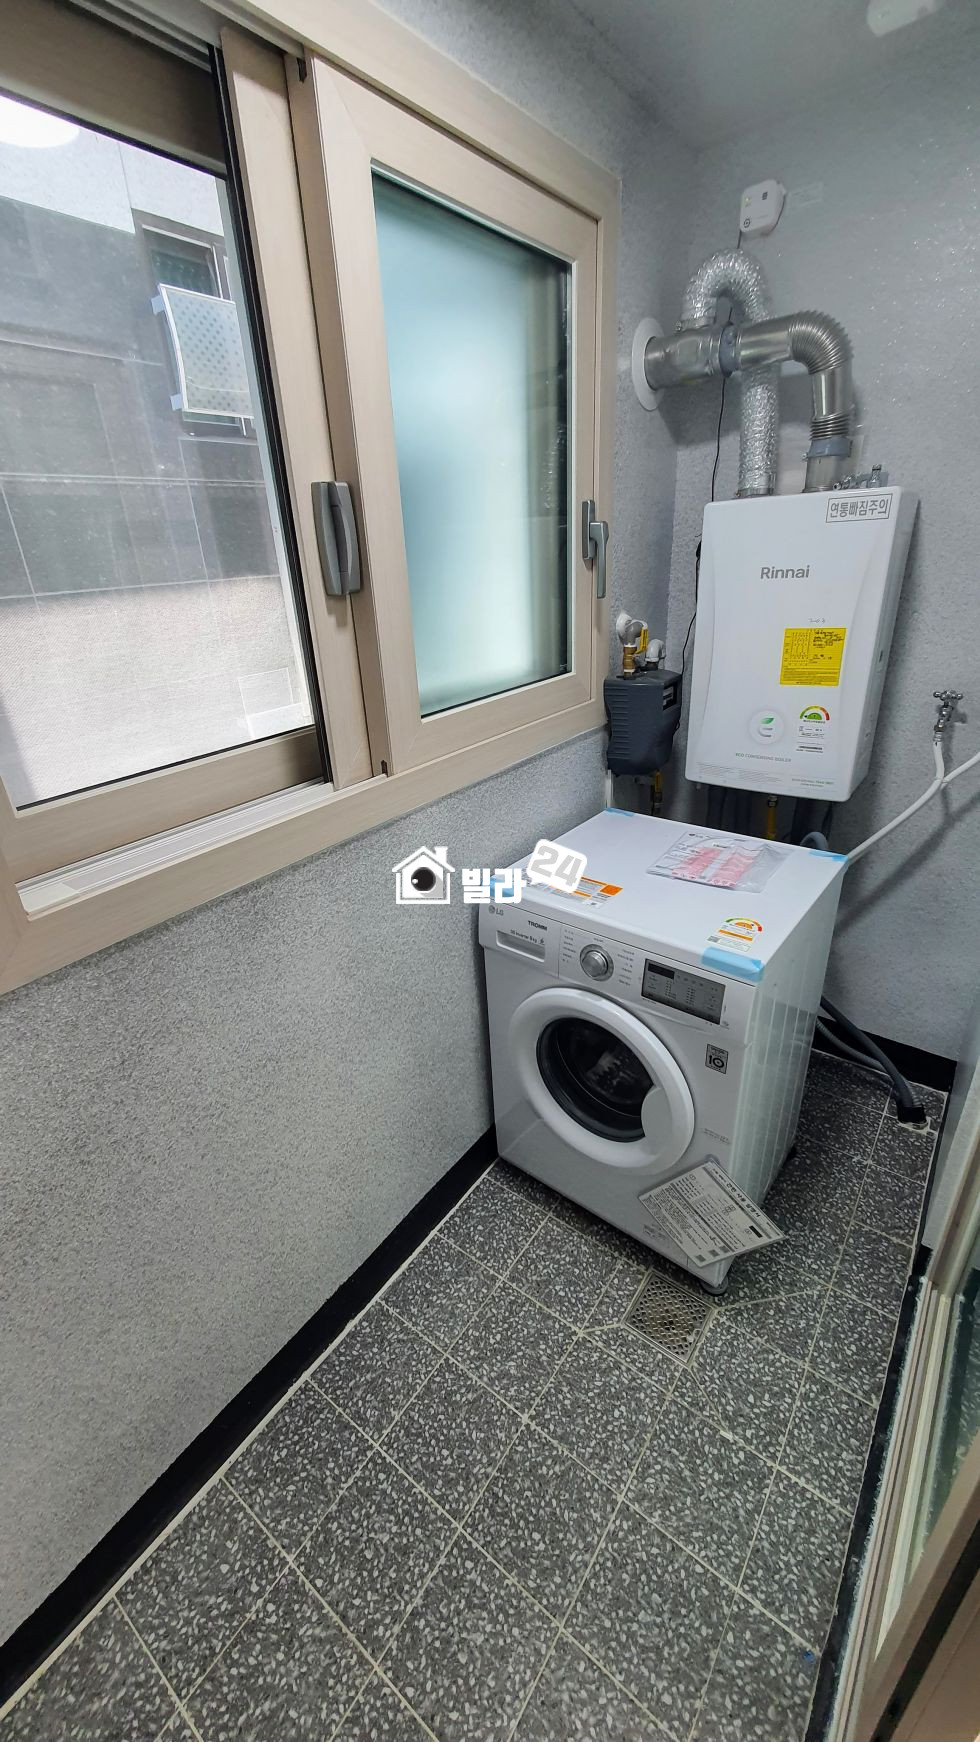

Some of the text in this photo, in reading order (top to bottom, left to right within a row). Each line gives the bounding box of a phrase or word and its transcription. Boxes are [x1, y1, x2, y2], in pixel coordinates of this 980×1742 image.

[829, 498, 889, 518] 연통빠짐주의
[760, 564, 811, 580] Rinnai
[495, 907, 504, 916] LG
[527, 920, 548, 931] TROMM
